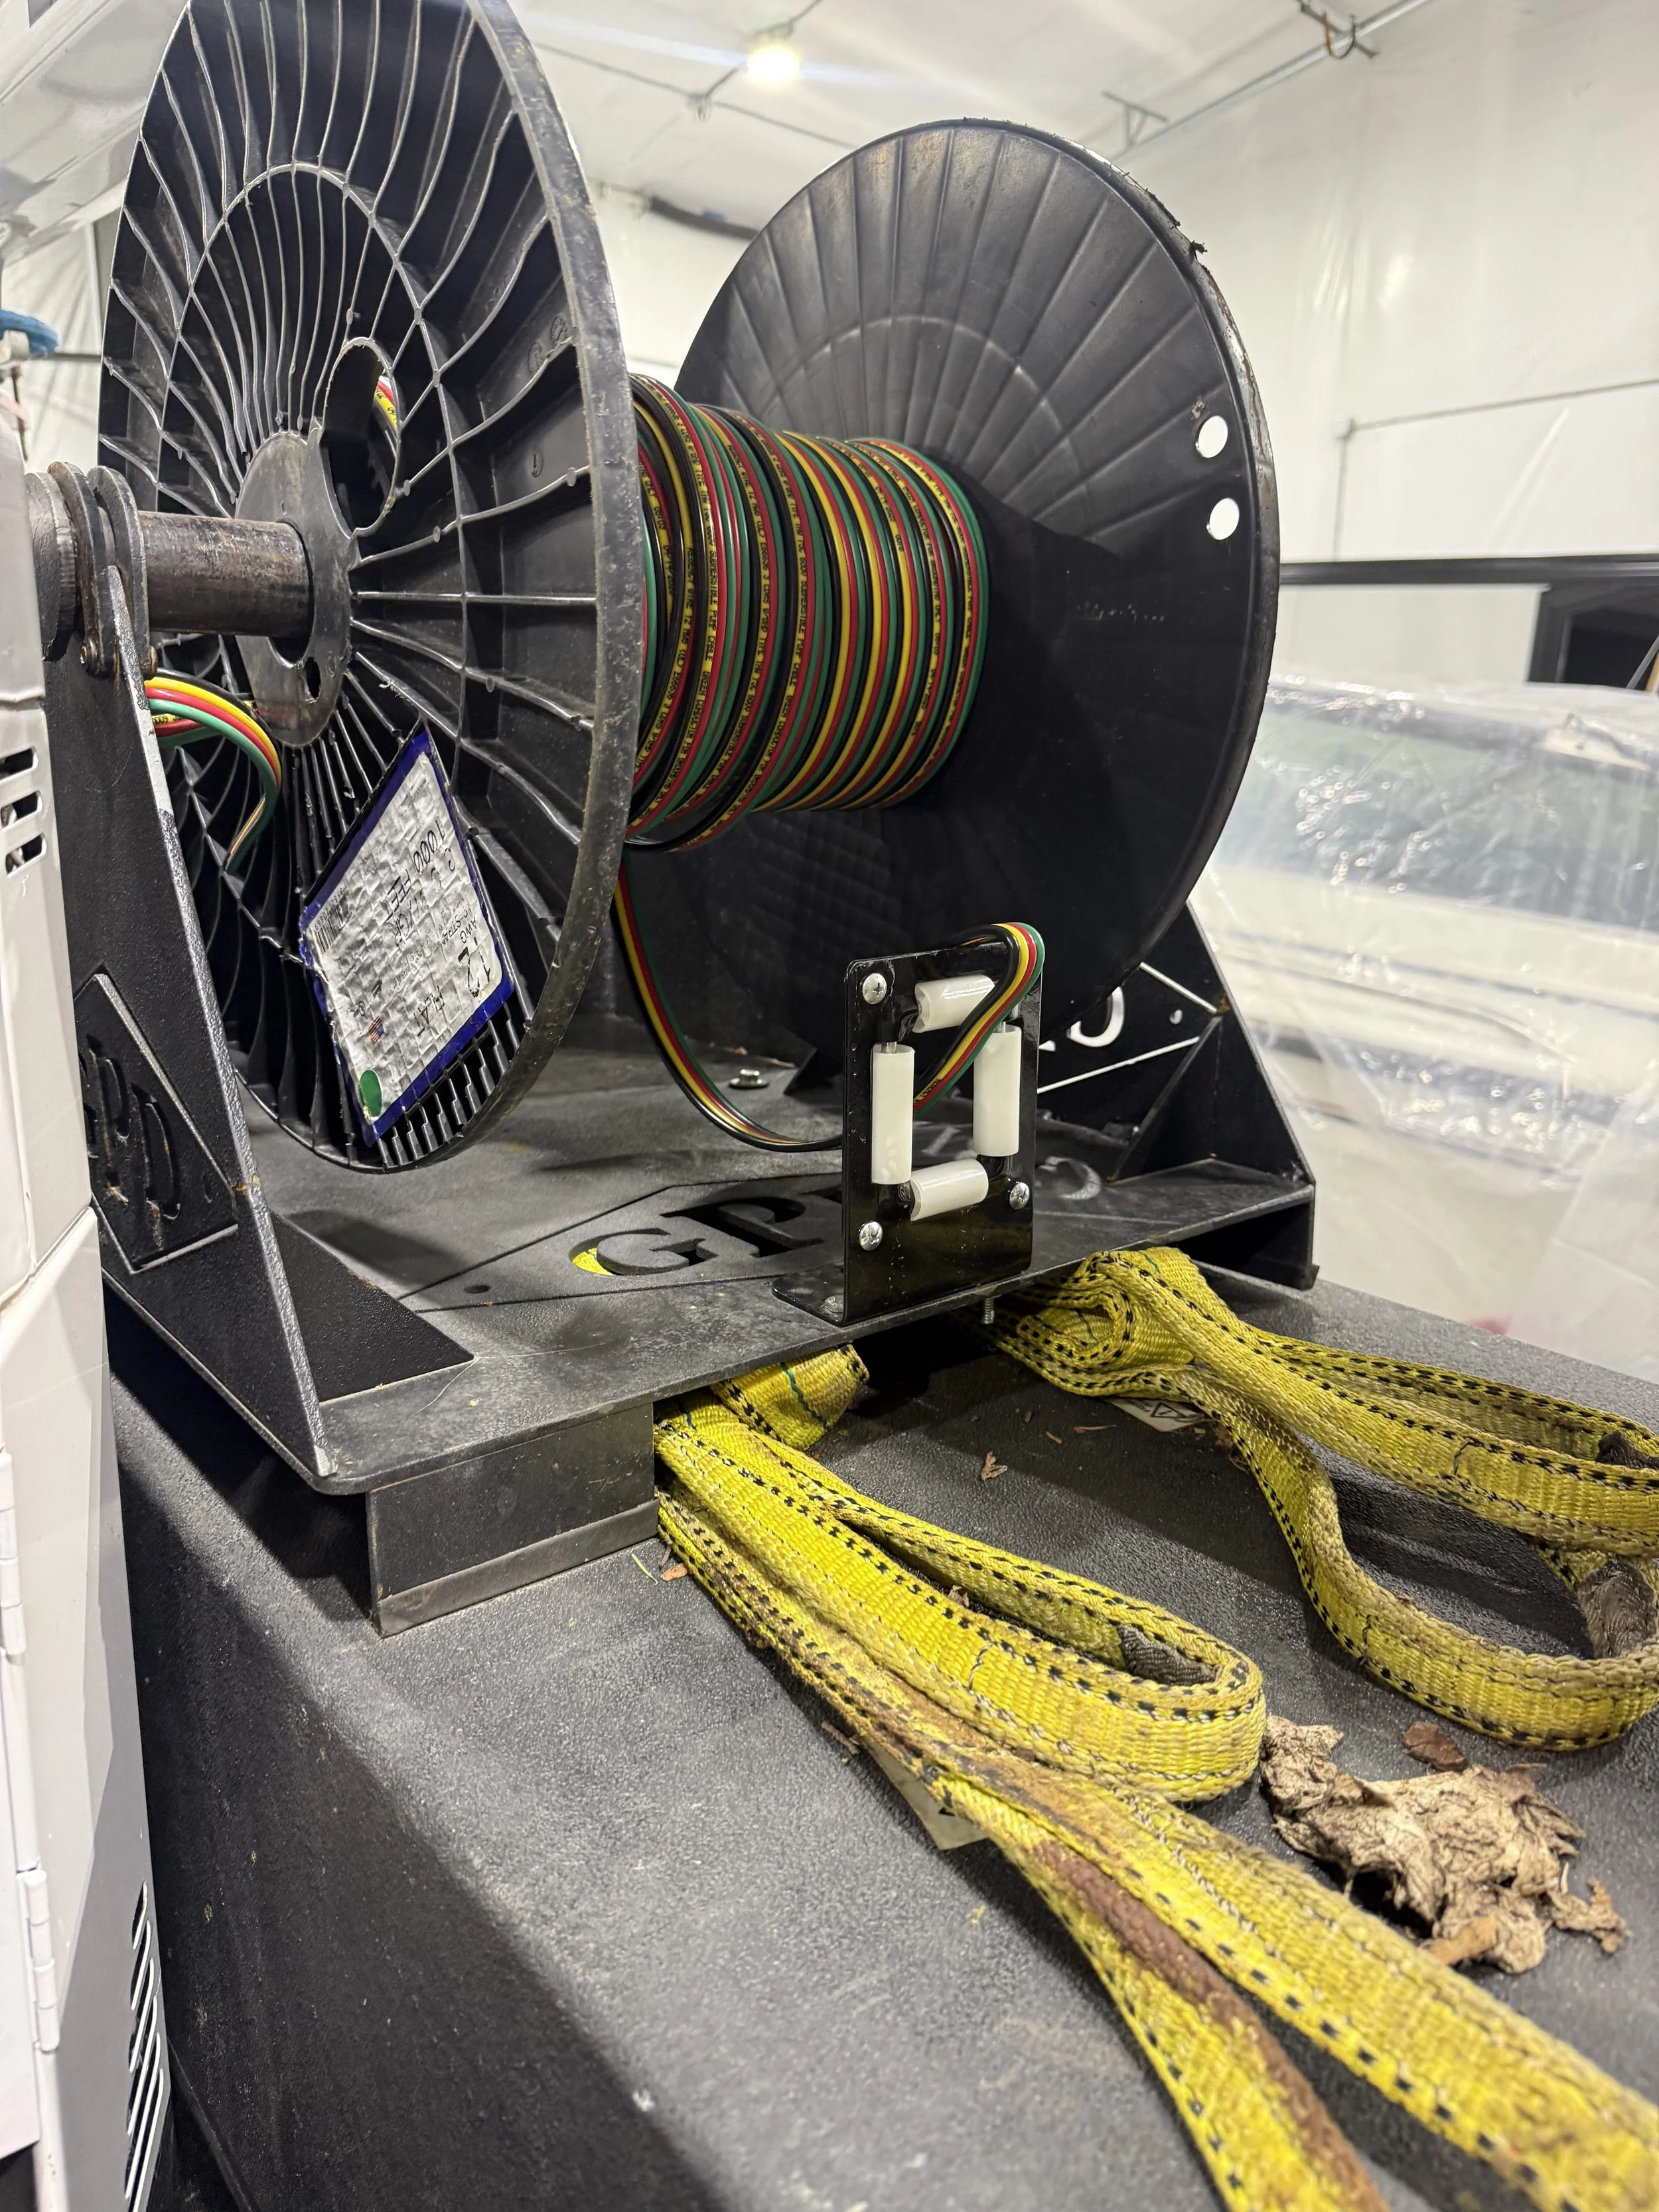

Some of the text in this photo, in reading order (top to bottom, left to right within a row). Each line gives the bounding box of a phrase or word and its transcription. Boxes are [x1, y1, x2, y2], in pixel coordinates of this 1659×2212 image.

[708, 550, 718, 605] SUBMERSIBLE
[684, 615, 691, 625] 12
[708, 609, 717, 630] PUMP
[798, 580, 808, 634] SUBMERSIBLE
[705, 635, 715, 661] CABLE
[698, 670, 710, 696] GREEN
[789, 662, 800, 686] CABLE
[411, 819, 446, 875] 1000
[385, 867, 412, 922] FEET
[459, 915, 478, 946] AWG
[457, 934, 491, 999] 12
[415, 986, 446, 1037] FLAT
